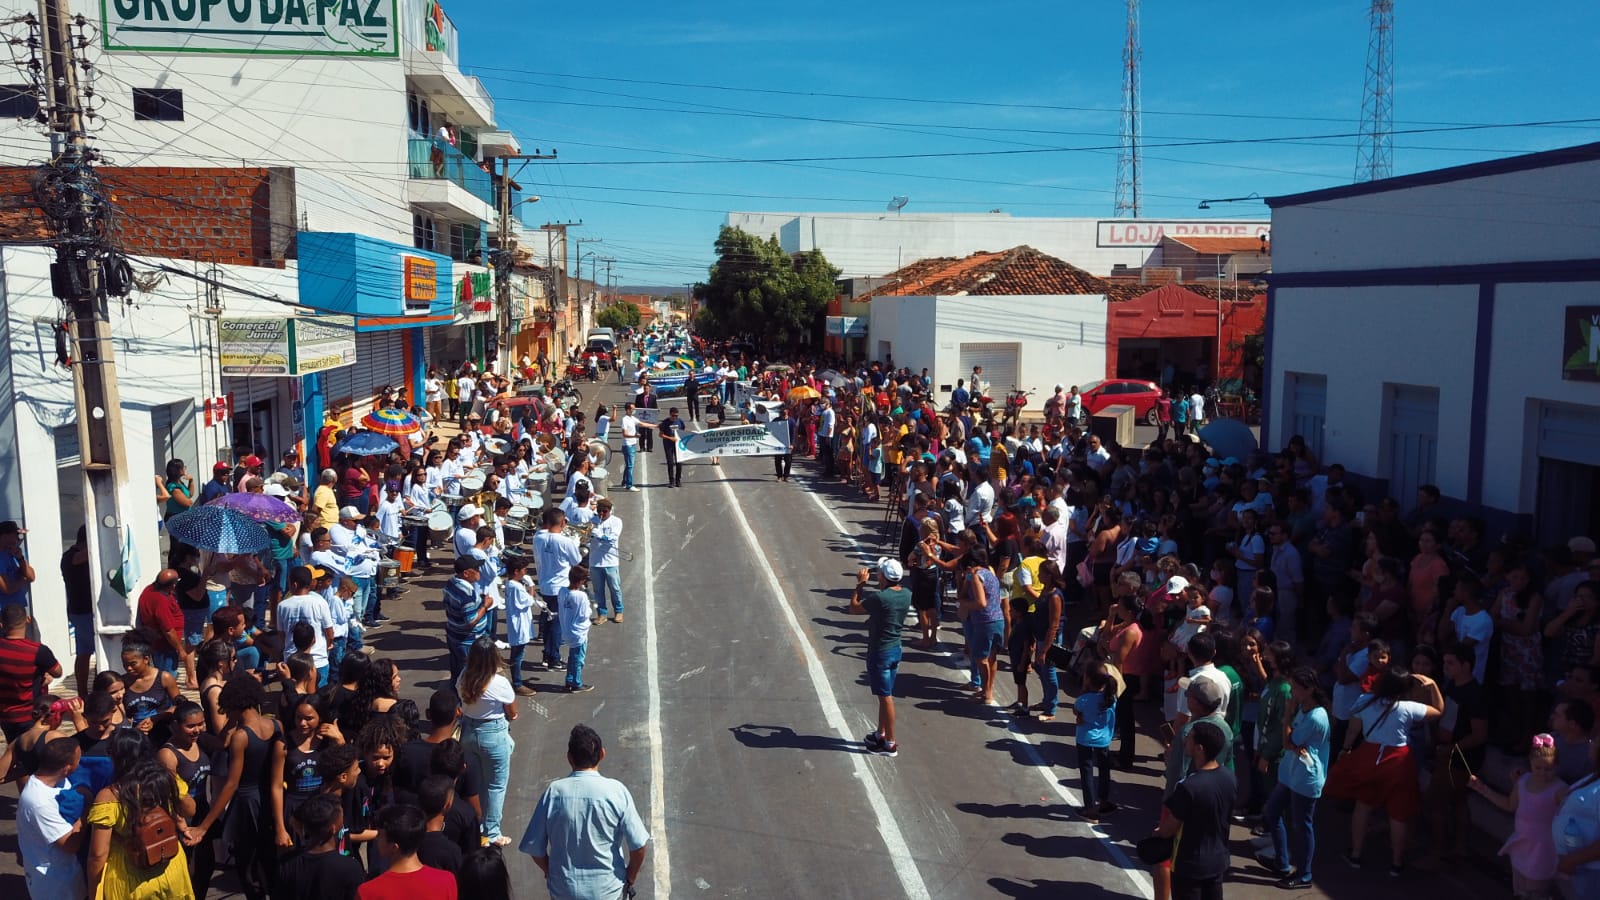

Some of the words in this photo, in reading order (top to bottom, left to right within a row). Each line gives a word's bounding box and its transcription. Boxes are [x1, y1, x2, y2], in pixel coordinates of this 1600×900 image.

[115, 0, 253, 23] GRUPO
[260, 0, 309, 25] DA
[316, 0, 387, 26] PAZ
[1109, 225, 1166, 243] LOJA
[221, 321, 280, 331] Comercial
